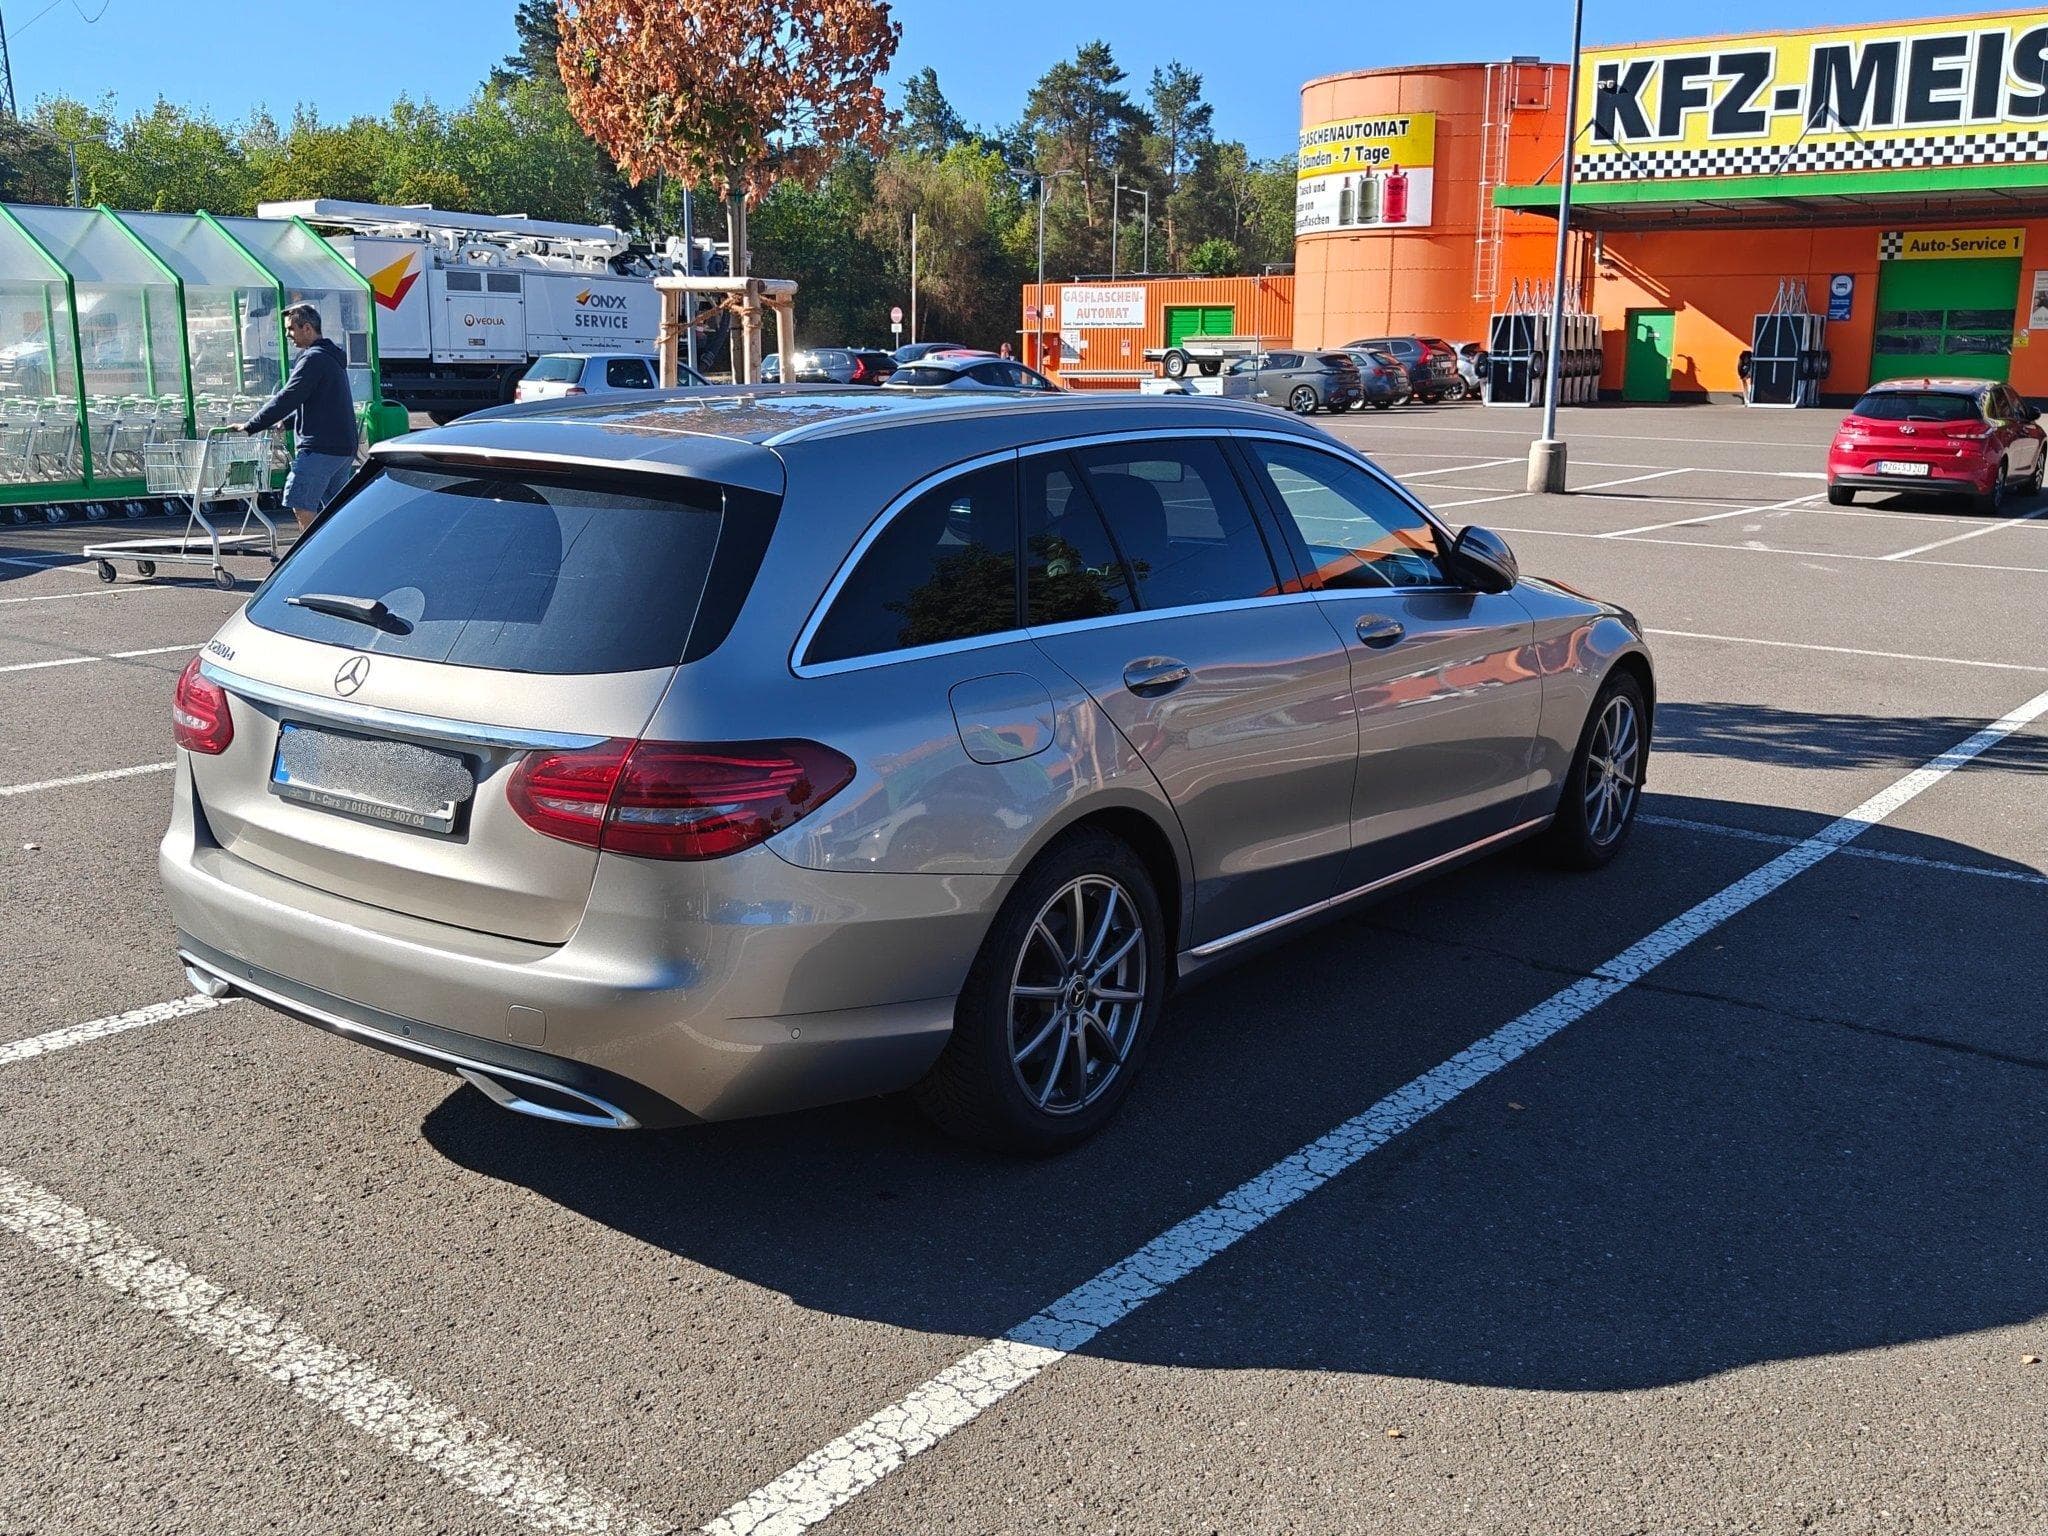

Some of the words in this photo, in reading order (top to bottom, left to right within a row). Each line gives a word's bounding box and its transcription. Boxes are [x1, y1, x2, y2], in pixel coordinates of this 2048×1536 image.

[1594, 27, 2048, 141] KFZ-MEIS
[1343, 147, 1351, 163] 7
[1355, 145, 1390, 165] Tage
[1909, 236, 2006, 252] Auto-Service
[2013, 235, 2019, 249] 1
[591, 294, 628, 309] ONYX
[1064, 290, 1143, 303] GASFLASCHEN-
[1076, 307, 1129, 319] AUTOMAT
[476, 317, 505, 326] VEOLIA
[575, 314, 628, 329] SERVICE
[351, 802, 392, 818] 0151/465
[394, 811, 412, 822] 407
[413, 815, 425, 825] 04
